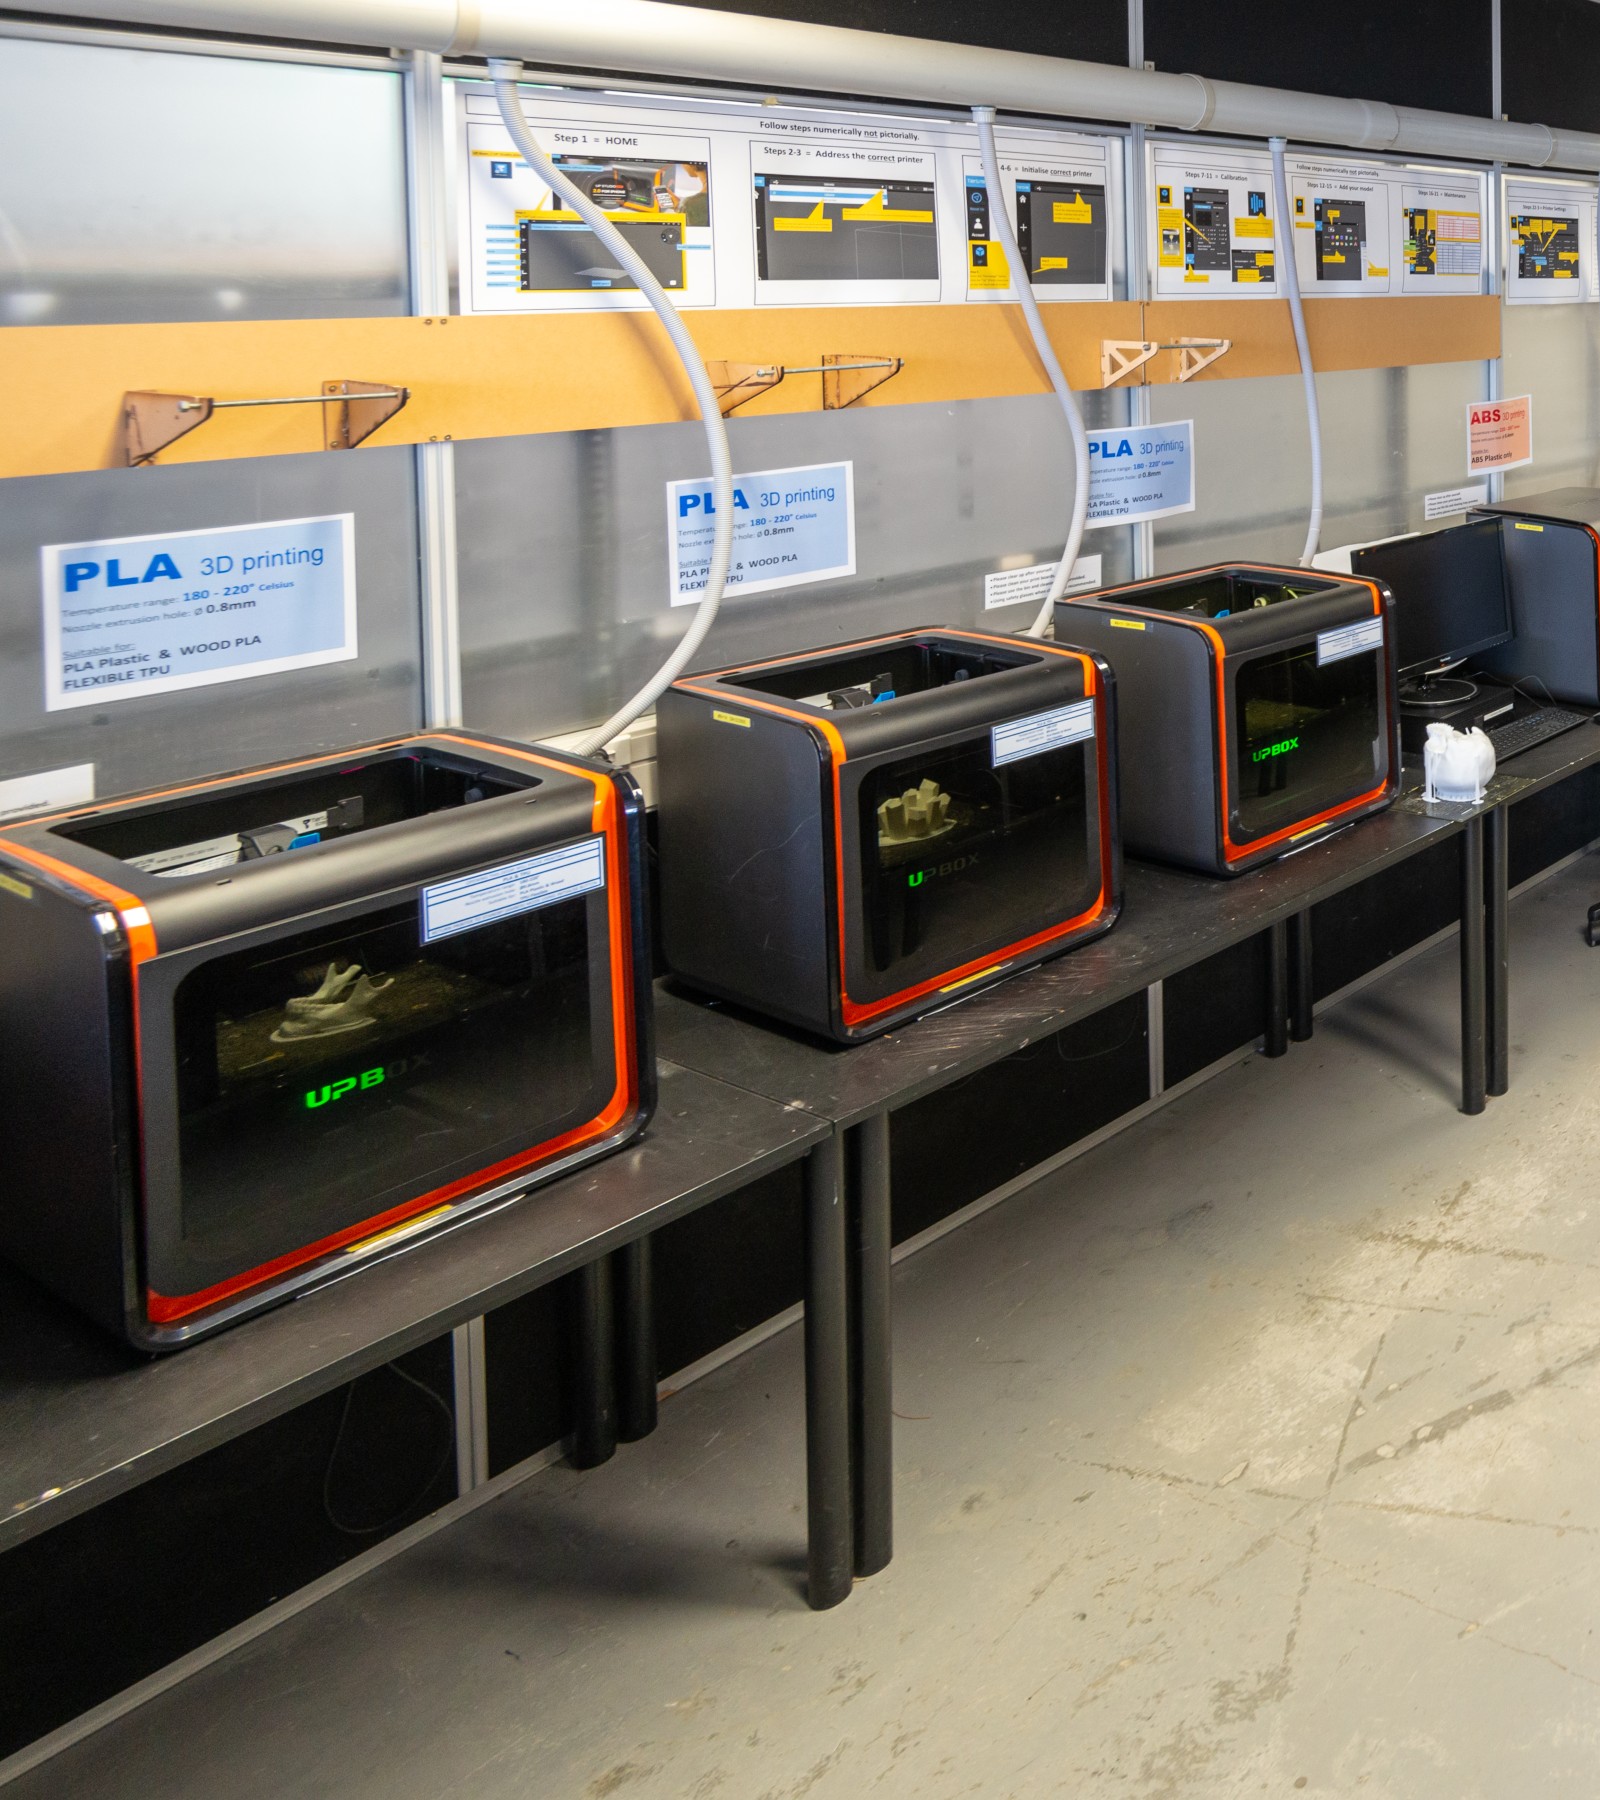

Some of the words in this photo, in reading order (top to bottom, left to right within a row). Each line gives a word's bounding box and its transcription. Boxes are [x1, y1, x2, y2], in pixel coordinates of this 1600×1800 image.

[554, 134, 578, 144] Step
[582, 135, 587, 143] 1
[606, 136, 638, 146] HOME
[760, 121, 788, 130] Follow
[814, 127, 862, 136] numerically
[880, 131, 920, 141] pictorially.
[764, 146, 786, 156] Steps
[788, 148, 802, 156] 2-3
[816, 150, 850, 159] Address
[852, 152, 866, 160] the
[868, 154, 896, 162] correct
[897, 156, 923, 164] printer
[1022, 166, 1048, 174] Initialise
[1471, 409, 1501, 425] ABS
[1088, 440, 1133, 459] PLA
[1140, 442, 1153, 454] 3D
[1156, 440, 1184, 455] printing
[1484, 453, 1502, 461] Plastic
[680, 489, 749, 517] PLA
[760, 492, 780, 507] 3D
[786, 487, 835, 507] printing
[1132, 494, 1152, 502] WOOD
[750, 518, 766, 526] 180
[764, 527, 794, 536] 0.8mm
[679, 539, 702, 548] Nozzle
[65, 553, 182, 592] PLA
[200, 556, 233, 575] 3D
[242, 548, 324, 575] printing
[680, 570, 698, 578] PLA
[748, 557, 779, 568] WOOD
[782, 554, 798, 563] PLA
[680, 580, 708, 591] FLEXI
[62, 602, 140, 617] Temperature
[143, 597, 179, 606] range:
[183, 590, 209, 602] 180
[224, 584, 254, 596] 220°
[259, 580, 294, 591] Celsius
[62, 623, 101, 633] Nozzle
[106, 615, 160, 627] extrusion
[163, 610, 191, 619] hole:
[206, 600, 256, 614] 0.8mm
[62, 646, 111, 659] Suitable
[114, 643, 135, 652] for:
[64, 662, 94, 673] PLA
[100, 653, 151, 668] Plastic
[159, 649, 171, 659] &
[180, 640, 231, 656] WOOD
[235, 635, 262, 647] PLA
[64, 670, 134, 690] FLEXIBLE
[139, 665, 170, 678] TPU
[1253, 737, 1299, 762] UPBOX
